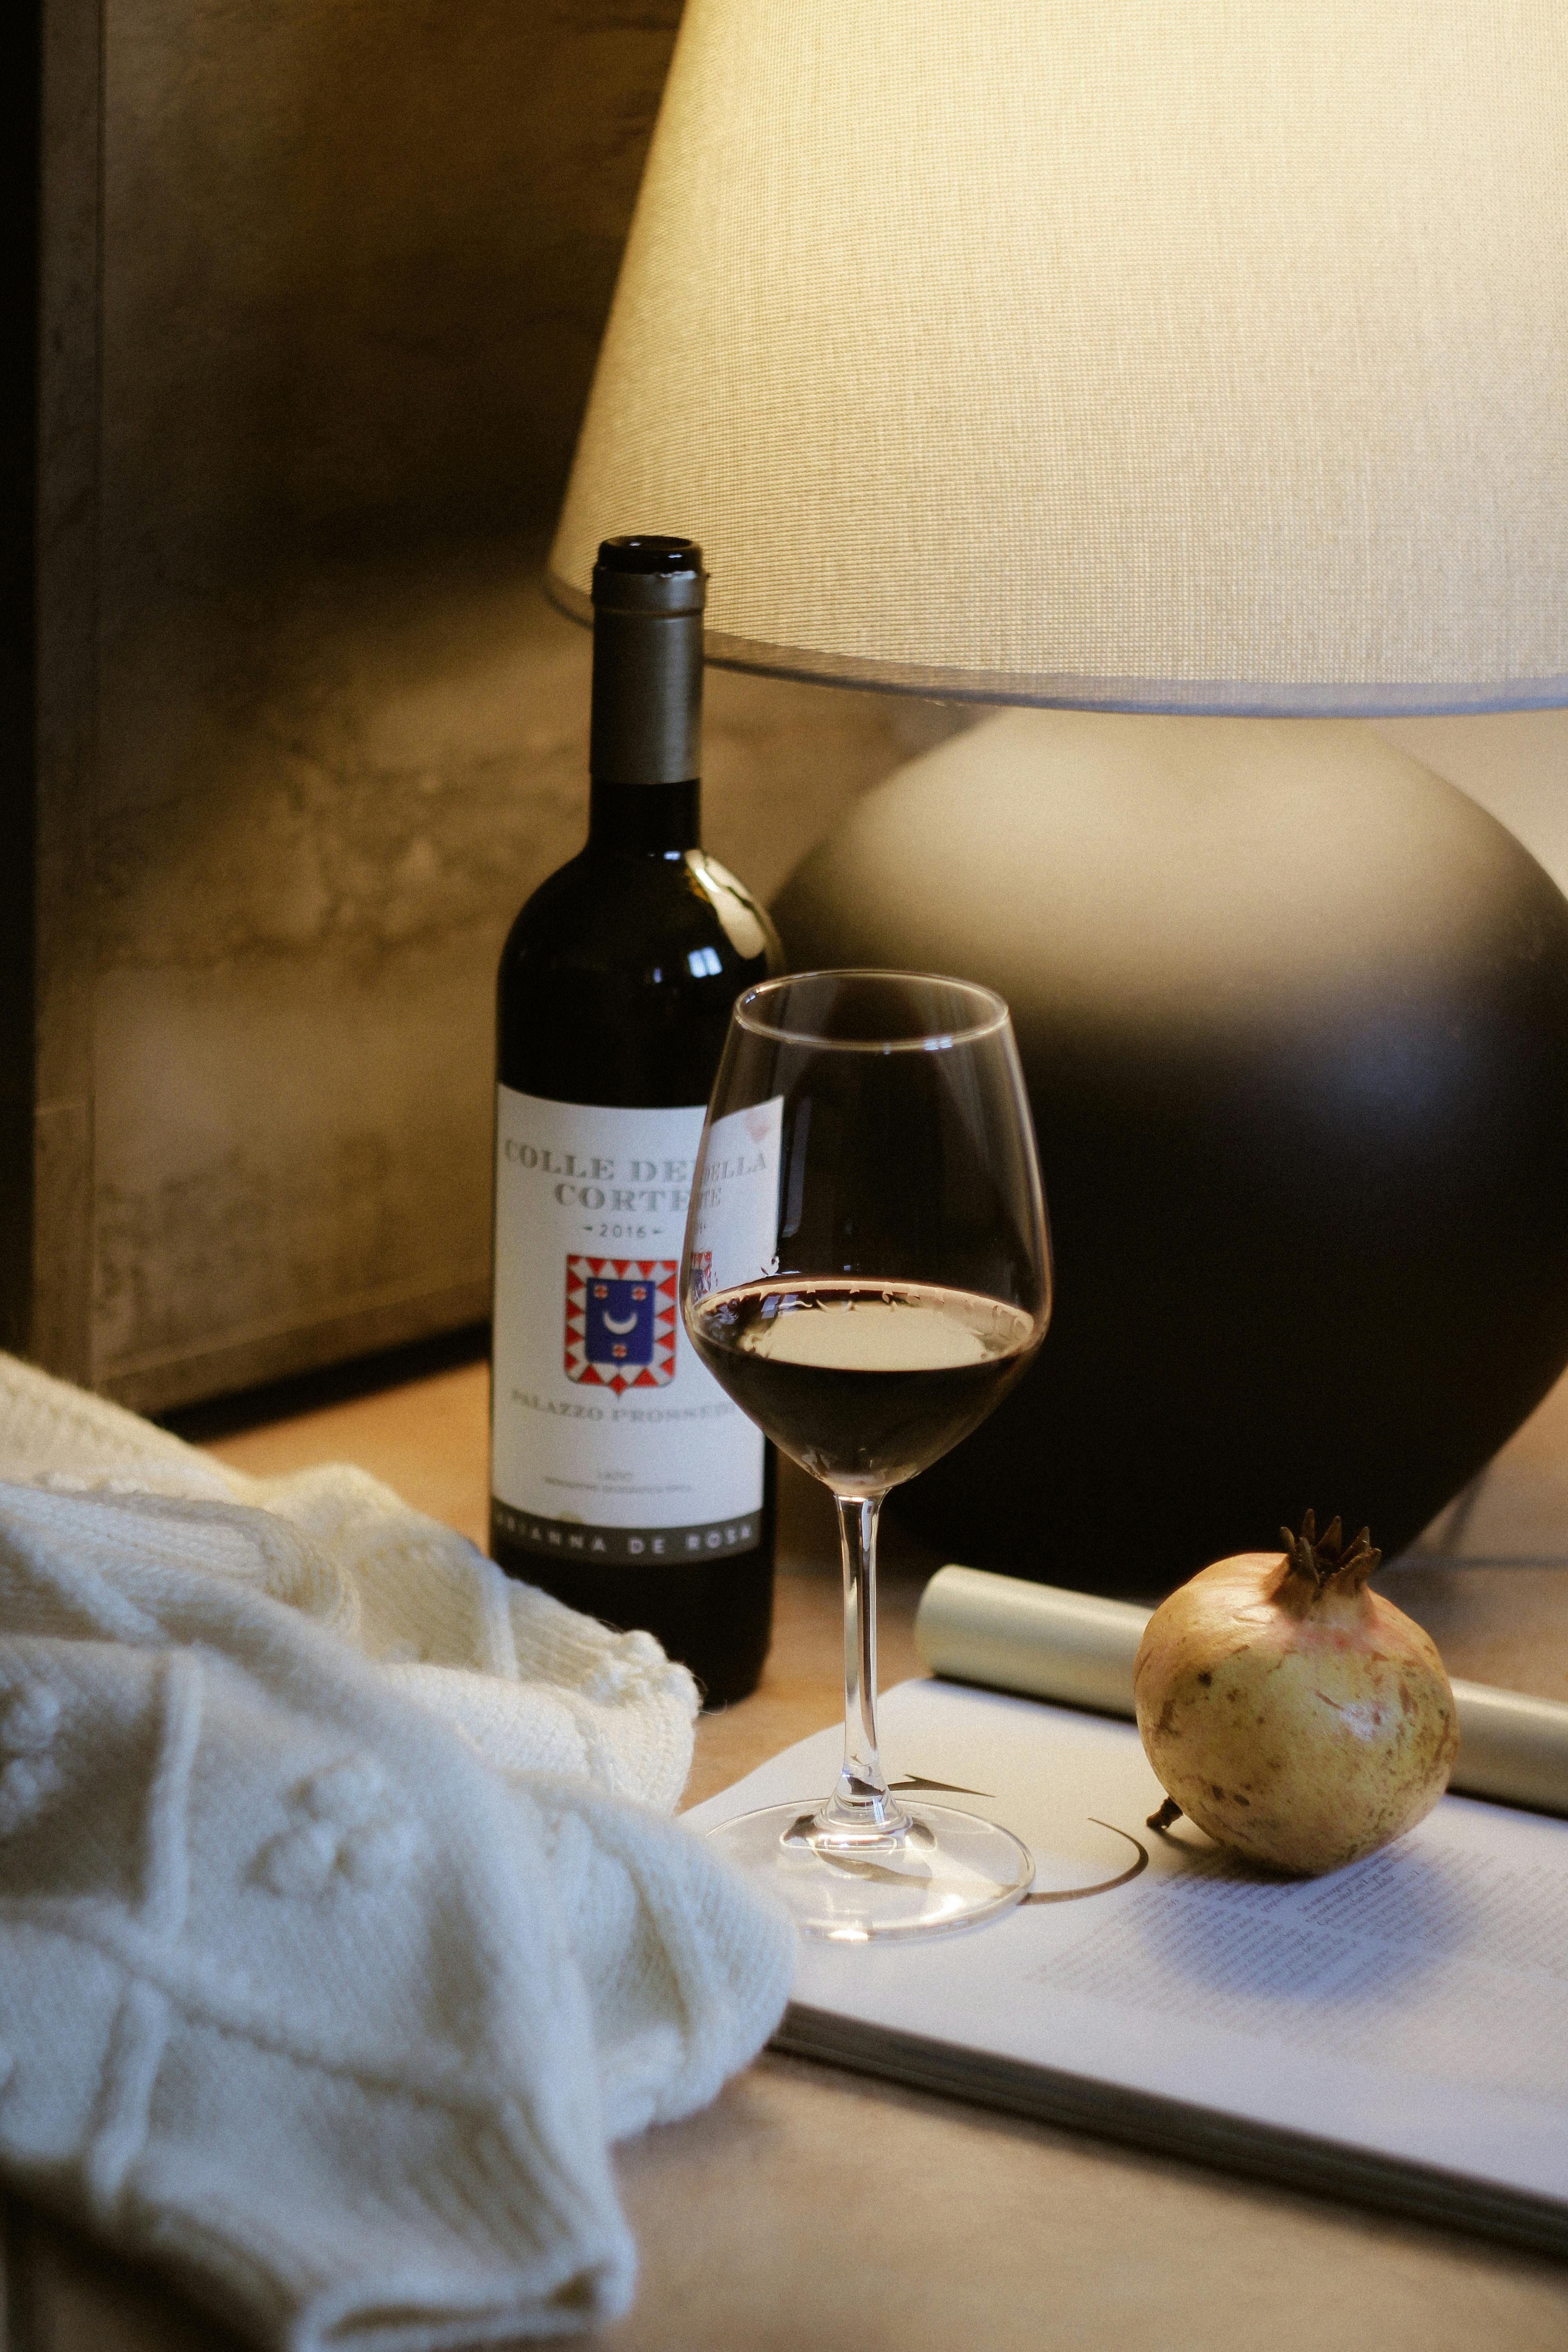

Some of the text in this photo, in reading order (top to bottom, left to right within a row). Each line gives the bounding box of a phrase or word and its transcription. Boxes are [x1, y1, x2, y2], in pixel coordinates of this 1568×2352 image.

[505, 1139, 614, 1180] COLLE
[554, 1184, 692, 1212] CORTE
[599, 1224, 646, 1238] 2016
[511, 1389, 604, 1421] PALAZZO
[629, 1538, 665, 1554] DE
[686, 1524, 752, 1551] ROSA
